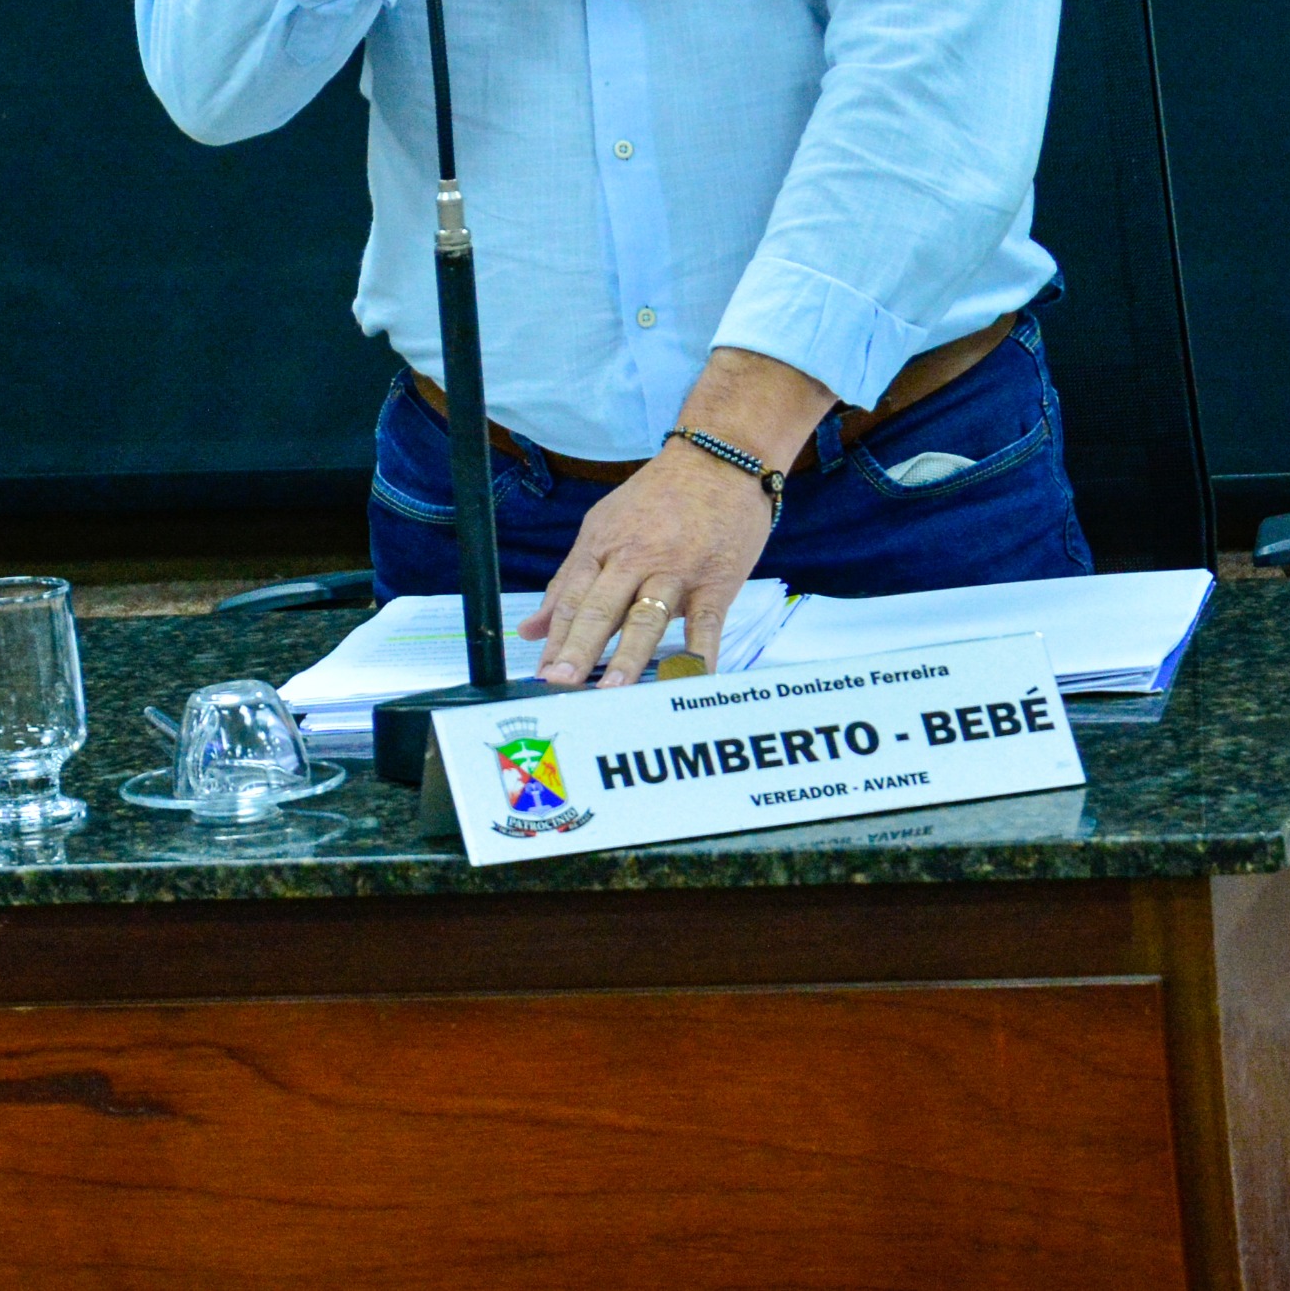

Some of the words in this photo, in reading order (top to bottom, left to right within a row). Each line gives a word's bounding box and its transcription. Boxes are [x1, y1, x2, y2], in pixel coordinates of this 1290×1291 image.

[671, 687, 771, 712] Humberto
[776, 674, 865, 697] Donizete
[870, 664, 950, 686] Ferreira
[596, 720, 880, 790] HUMBERTO
[921, 686, 1055, 747] BEBÉ
[750, 783, 848, 806] VEREADOR
[864, 771, 931, 792] AVANTE
